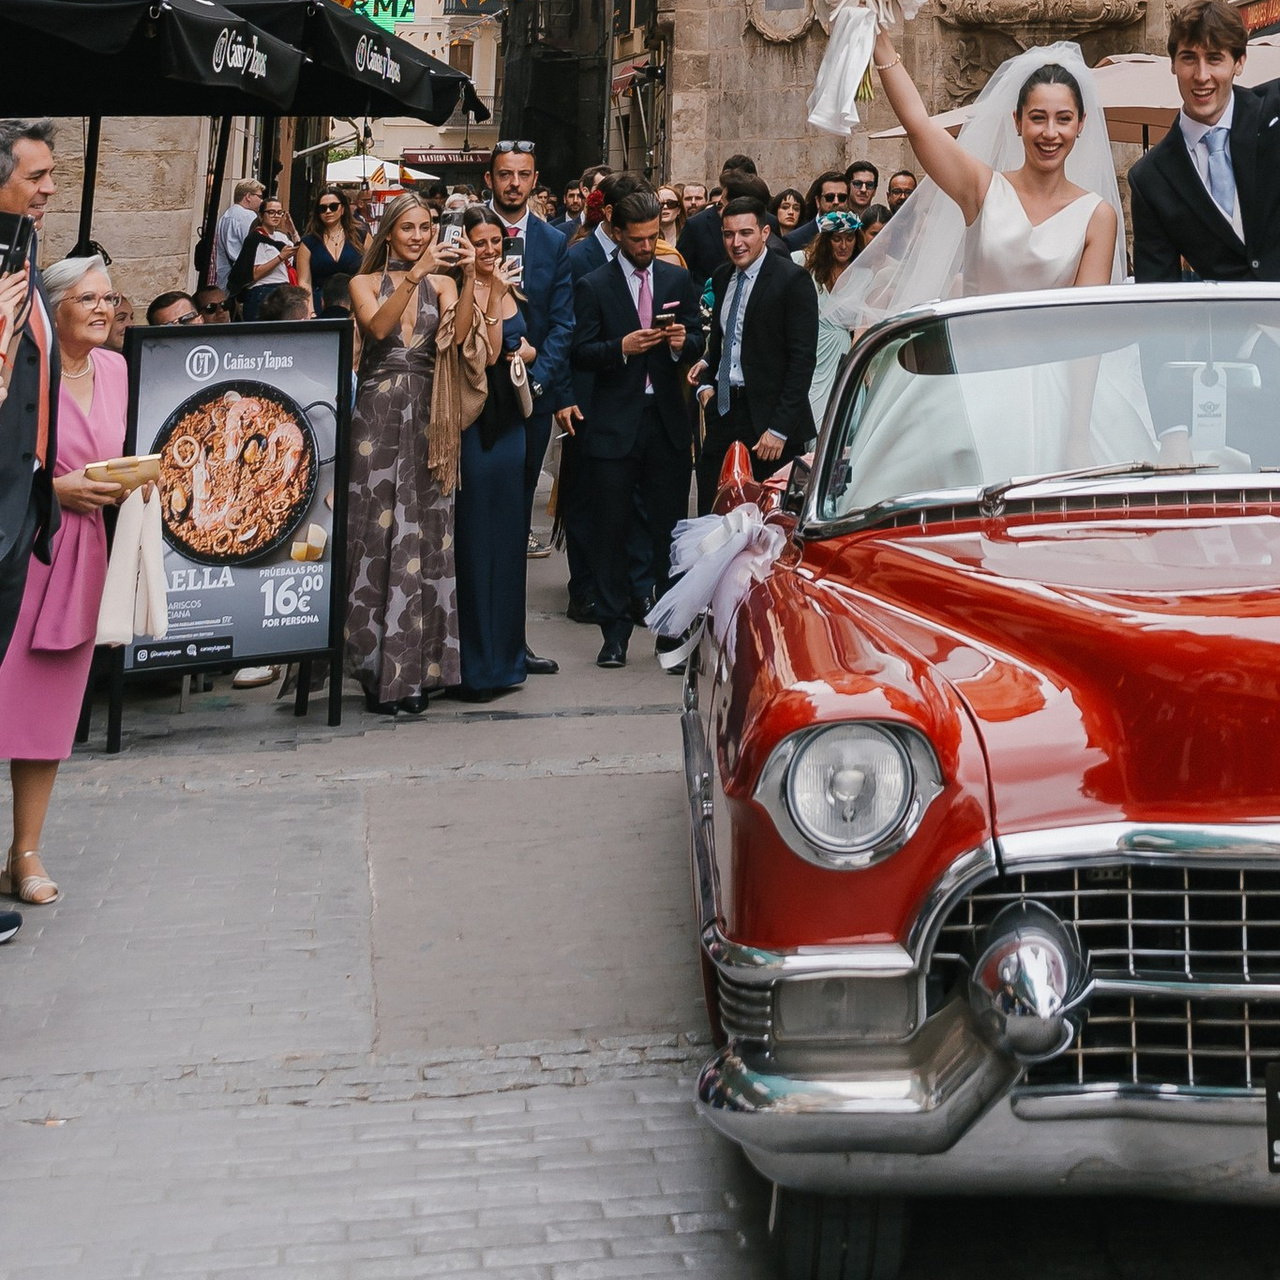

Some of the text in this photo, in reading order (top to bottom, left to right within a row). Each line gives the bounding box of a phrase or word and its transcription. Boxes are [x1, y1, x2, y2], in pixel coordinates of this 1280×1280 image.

[223, 352, 256, 370] Cañas
[257, 357, 264, 371] y
[263, 350, 293, 370] Tapas
[306, 564, 324, 574] POR
[165, 566, 235, 593] ELLA
[168, 600, 202, 610] ARISCOS
[262, 614, 319, 628] POR PERSONA
